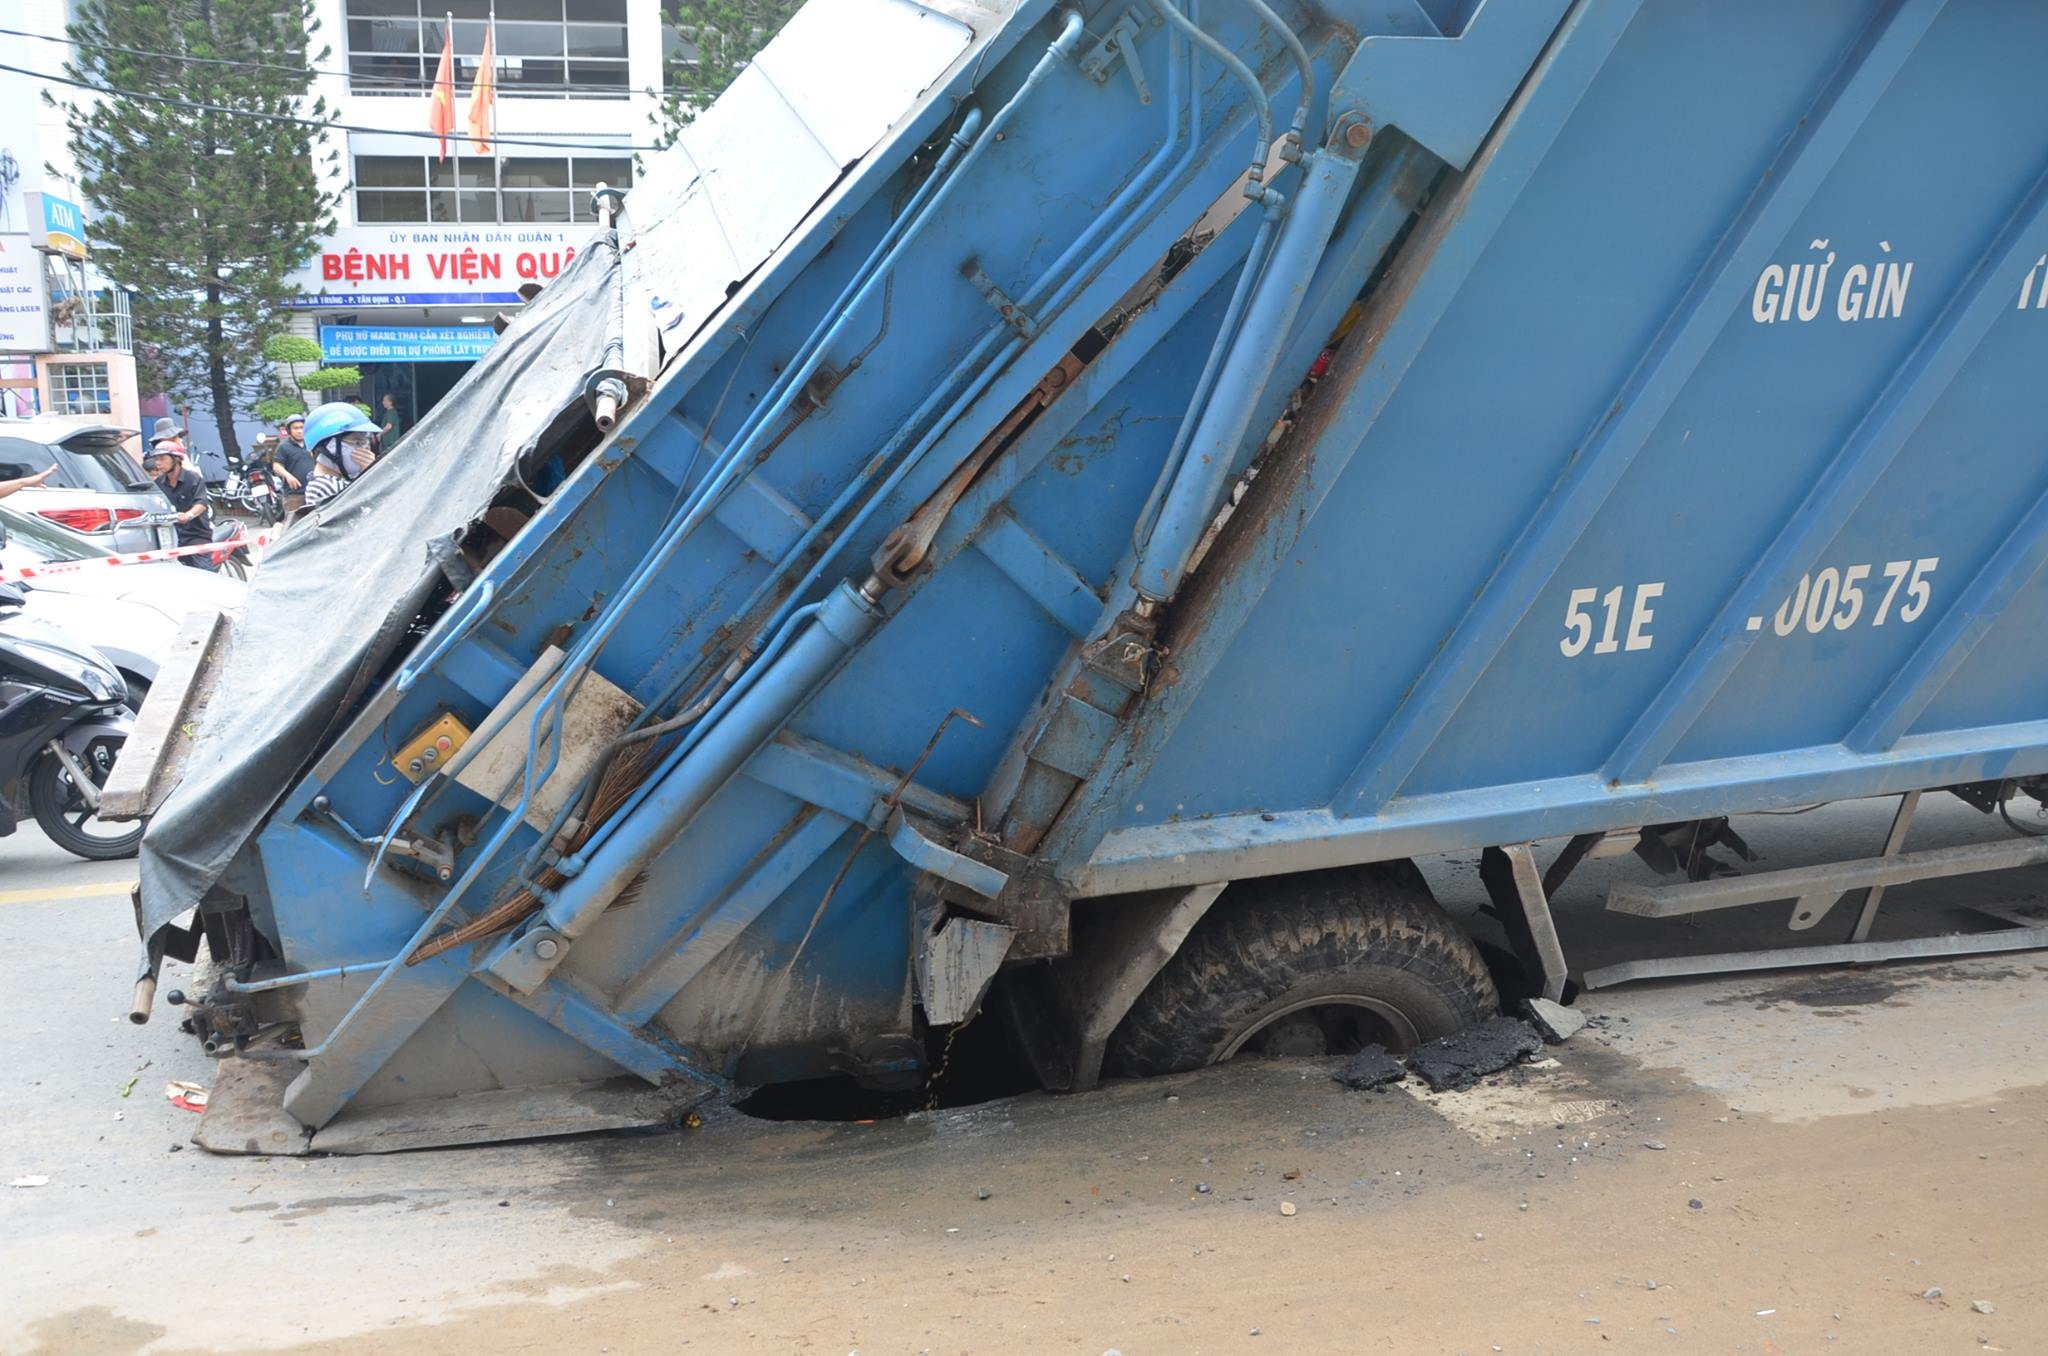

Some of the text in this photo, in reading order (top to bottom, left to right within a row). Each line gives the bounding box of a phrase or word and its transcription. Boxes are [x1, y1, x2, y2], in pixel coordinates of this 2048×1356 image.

[51, 202, 76, 232] ATM
[413, 233, 439, 243] BAN
[444, 231, 480, 243] NHÂN
[486, 231, 512, 243] DÂN
[557, 232, 564, 242] 1
[321, 247, 410, 287] BỆNH
[426, 246, 501, 285] VIỆN
[1751, 238, 1914, 324] GIỮ GÌN
[16, 304, 41, 312] LASER
[370, 331, 397, 341] MANG
[398, 331, 418, 341] THAI
[1559, 582, 1666, 657] 51E
